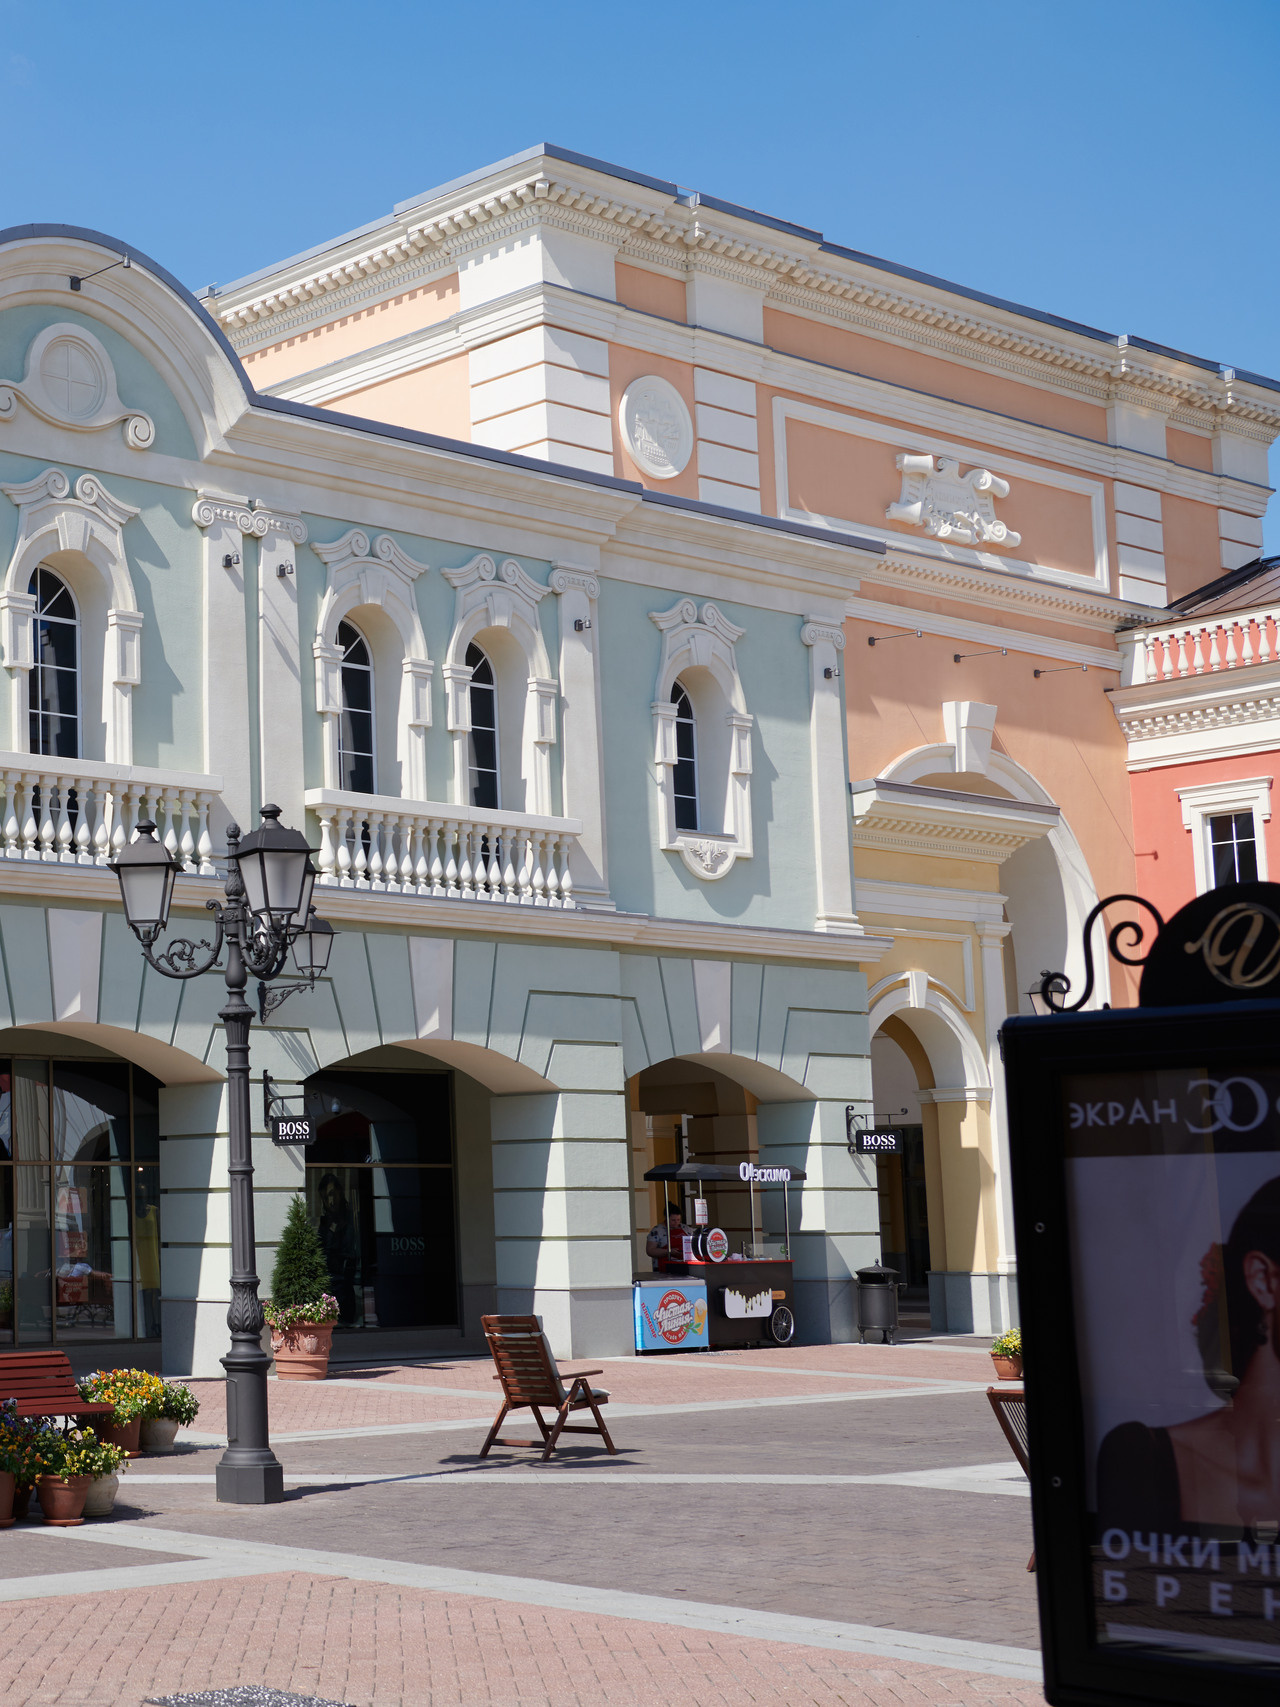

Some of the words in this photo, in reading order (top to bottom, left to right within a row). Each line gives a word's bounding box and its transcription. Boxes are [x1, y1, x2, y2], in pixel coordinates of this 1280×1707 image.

[1067, 1097, 1178, 1129] ЭКРАН
[278, 1121, 310, 1135] BOSS
[862, 1134, 896, 1146] BOSS
[391, 1237, 425, 1251] BOSS
[653, 1301, 694, 1322] Чистая
[658, 1313, 693, 1336] Линия
[1101, 1527, 1221, 1571] ОЧКИ
